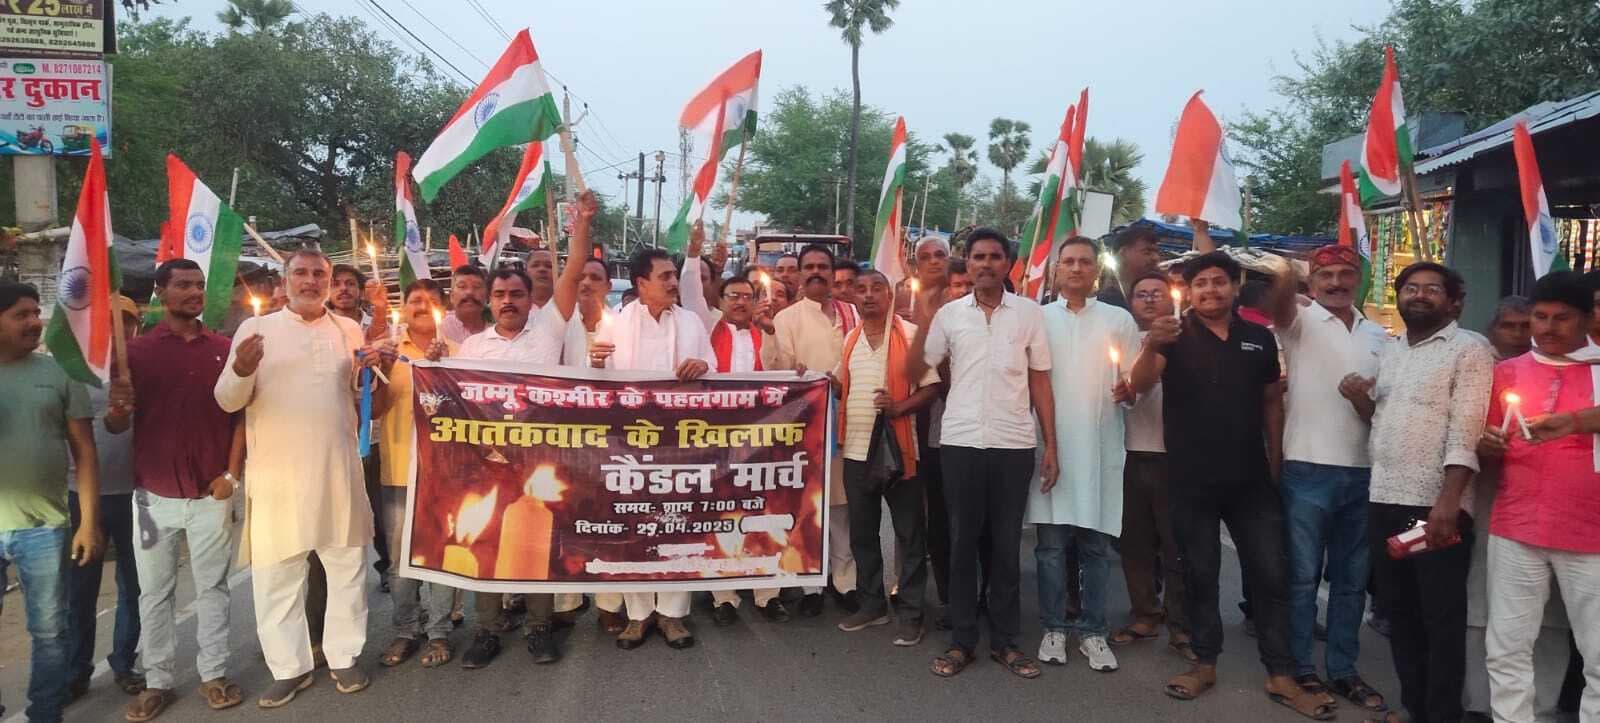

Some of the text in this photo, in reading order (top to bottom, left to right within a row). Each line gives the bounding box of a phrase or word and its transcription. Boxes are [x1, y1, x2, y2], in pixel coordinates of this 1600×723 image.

[61, 4, 83, 15] लाख
[85, 3, 93, 15] में
[21, 78, 102, 107] दुकान
[459, 382, 787, 408] जम्मू-कश्मीर के पहलगाम में
[430, 415, 806, 449] आतंकवाद के खिलाफ
[601, 451, 808, 494] कैंडल मार्च
[613, 497, 765, 514] समय- शाम 7:00 बजे
[575, 520, 629, 535] दिनांक-
